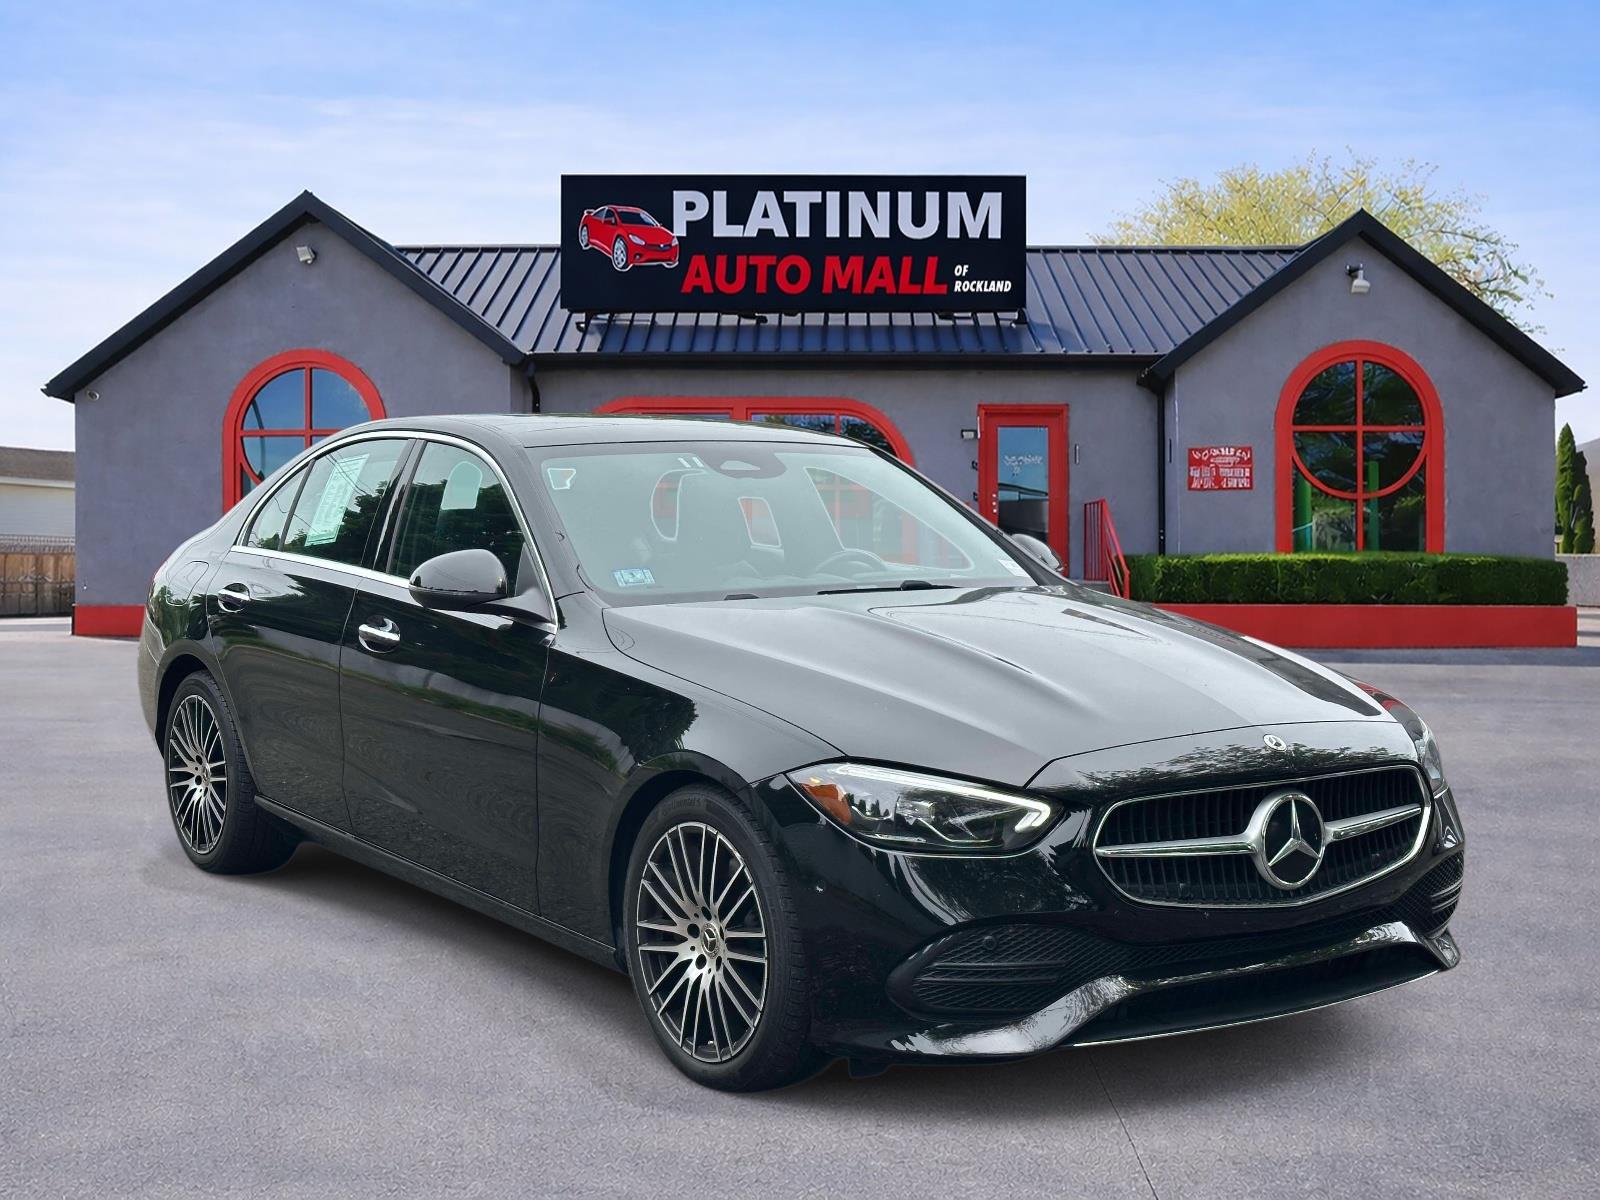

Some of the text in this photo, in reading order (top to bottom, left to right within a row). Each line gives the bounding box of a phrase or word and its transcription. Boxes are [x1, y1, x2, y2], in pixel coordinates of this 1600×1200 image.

[672, 190, 1003, 240] PLATINUM
[681, 254, 948, 295] AUTO MALL
[954, 264, 969, 277] OF
[954, 280, 1012, 293] ROCKLAND
